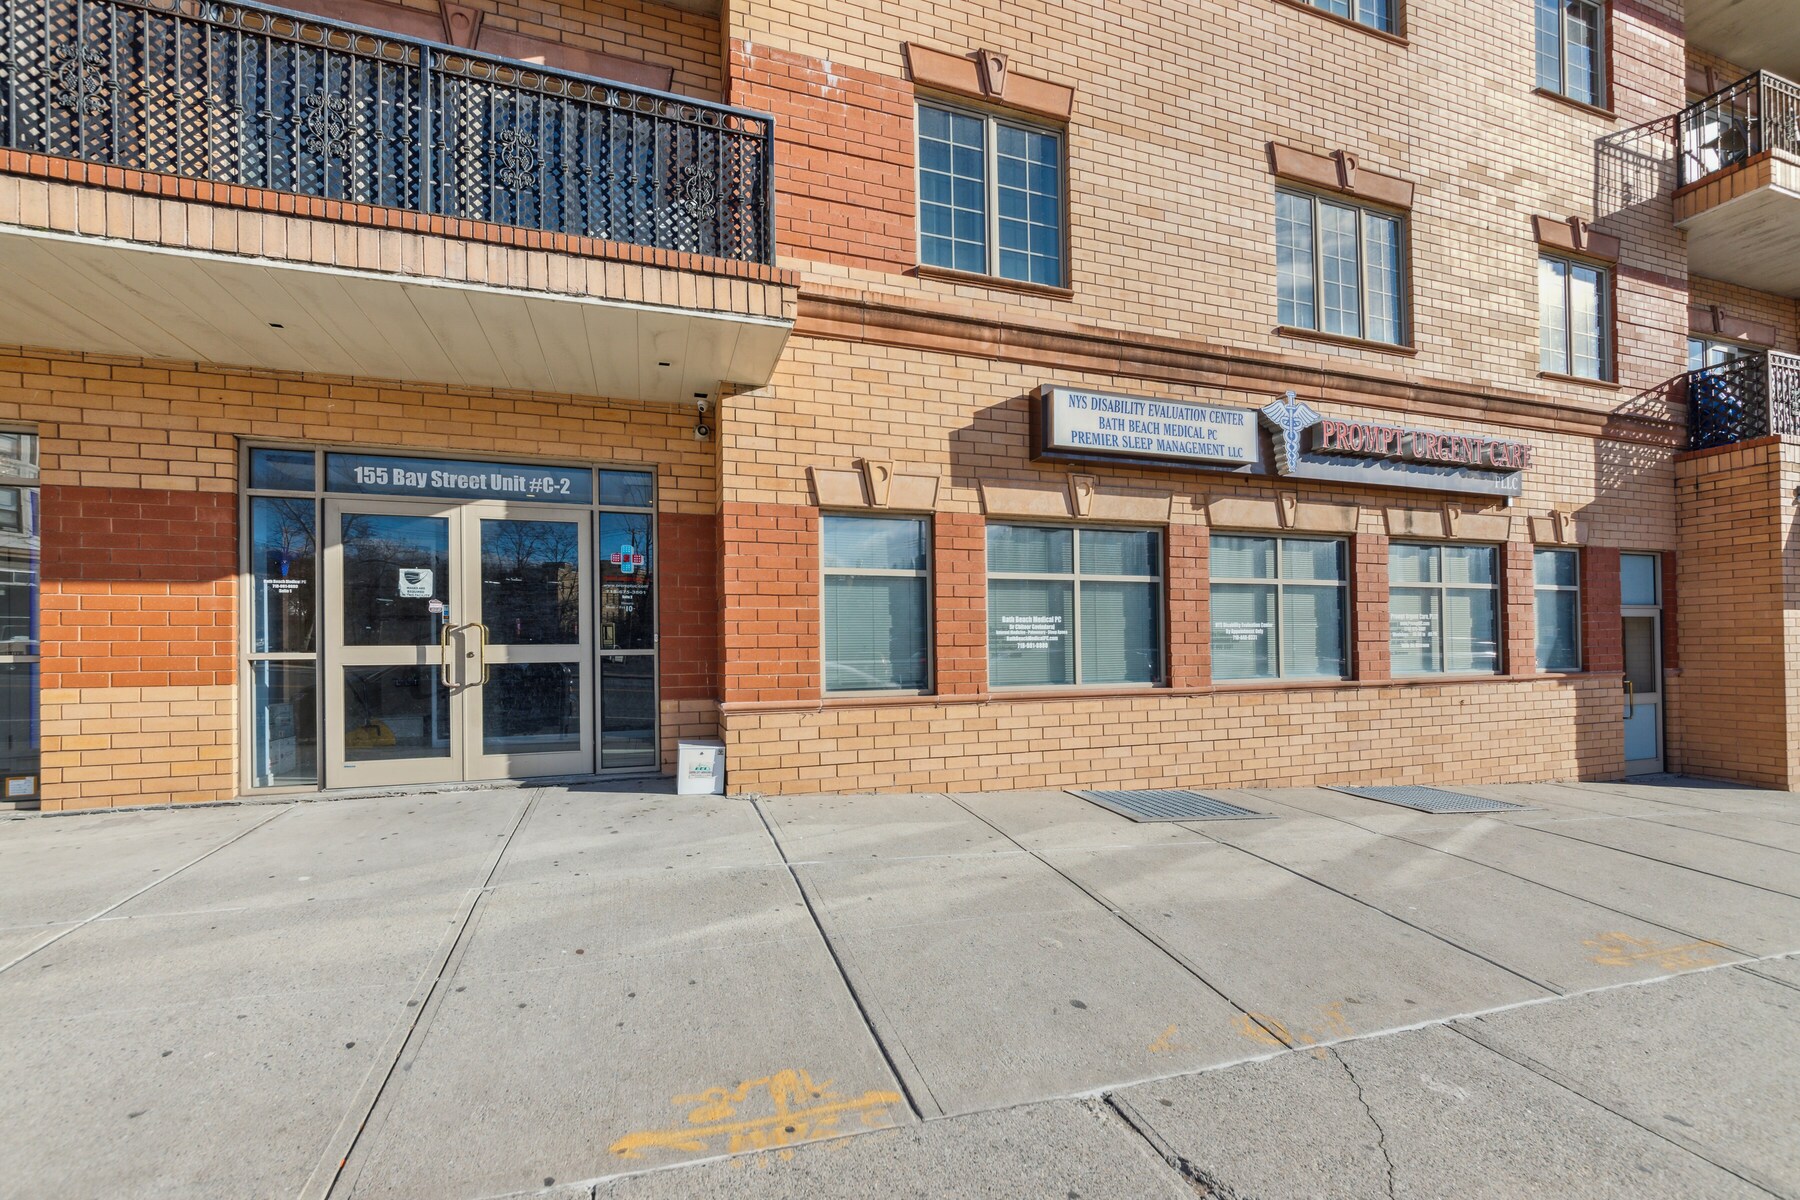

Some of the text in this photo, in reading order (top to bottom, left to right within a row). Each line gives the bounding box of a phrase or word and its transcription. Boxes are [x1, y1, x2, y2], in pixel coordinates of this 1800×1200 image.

[1068, 394, 1244, 426] NYS DISABILITY EVALUATION CENTER
[1098, 416, 1218, 441] BATH BEACH MEDICAL PC
[1071, 430, 1244, 458] PREMIER SLEEP MANAGEMENT LLC
[1322, 420, 1533, 469] PROMPT URGENT CARE
[354, 466, 570, 495] 155 Bay Street Unit #C-2
[1495, 476, 1518, 490] PLLC
